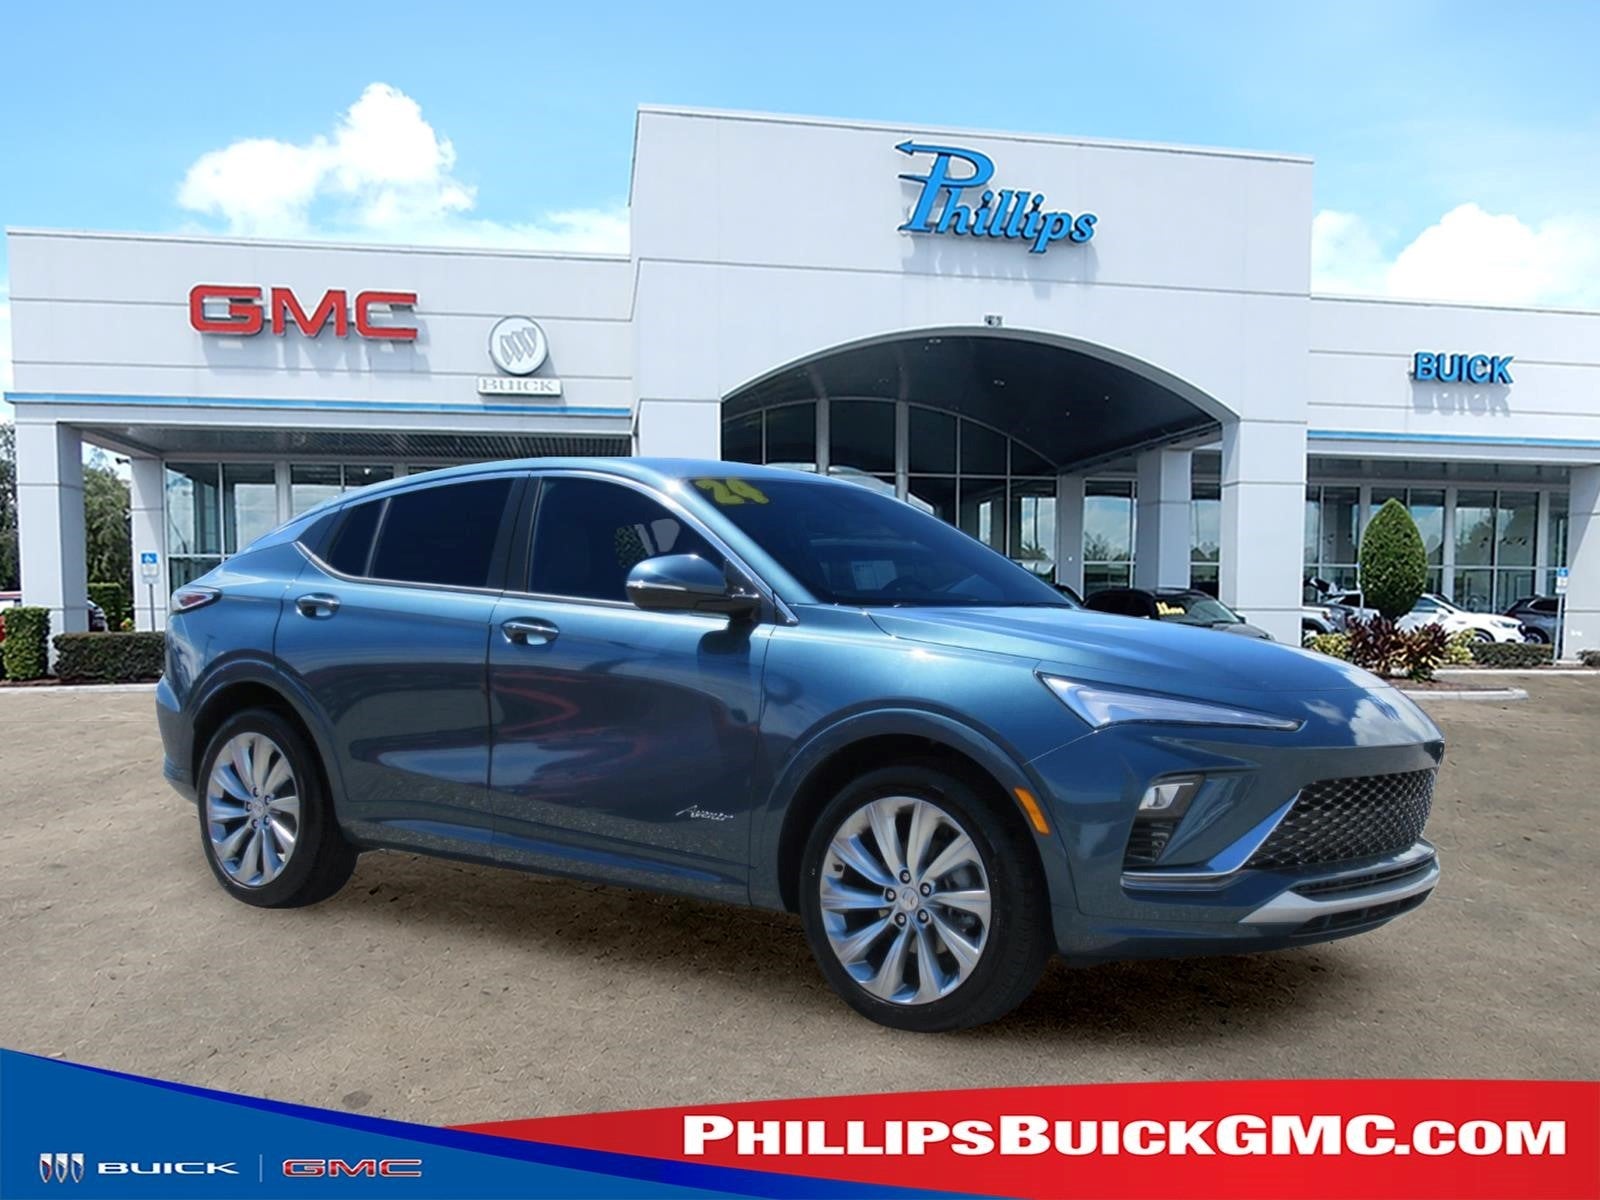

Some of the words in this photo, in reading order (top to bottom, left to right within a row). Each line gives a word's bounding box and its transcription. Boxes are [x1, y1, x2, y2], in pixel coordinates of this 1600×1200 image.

[895, 139, 1097, 254] Phillips
[189, 284, 418, 341] GMC
[481, 378, 554, 392] BUICK
[1413, 351, 1514, 384] BUICK
